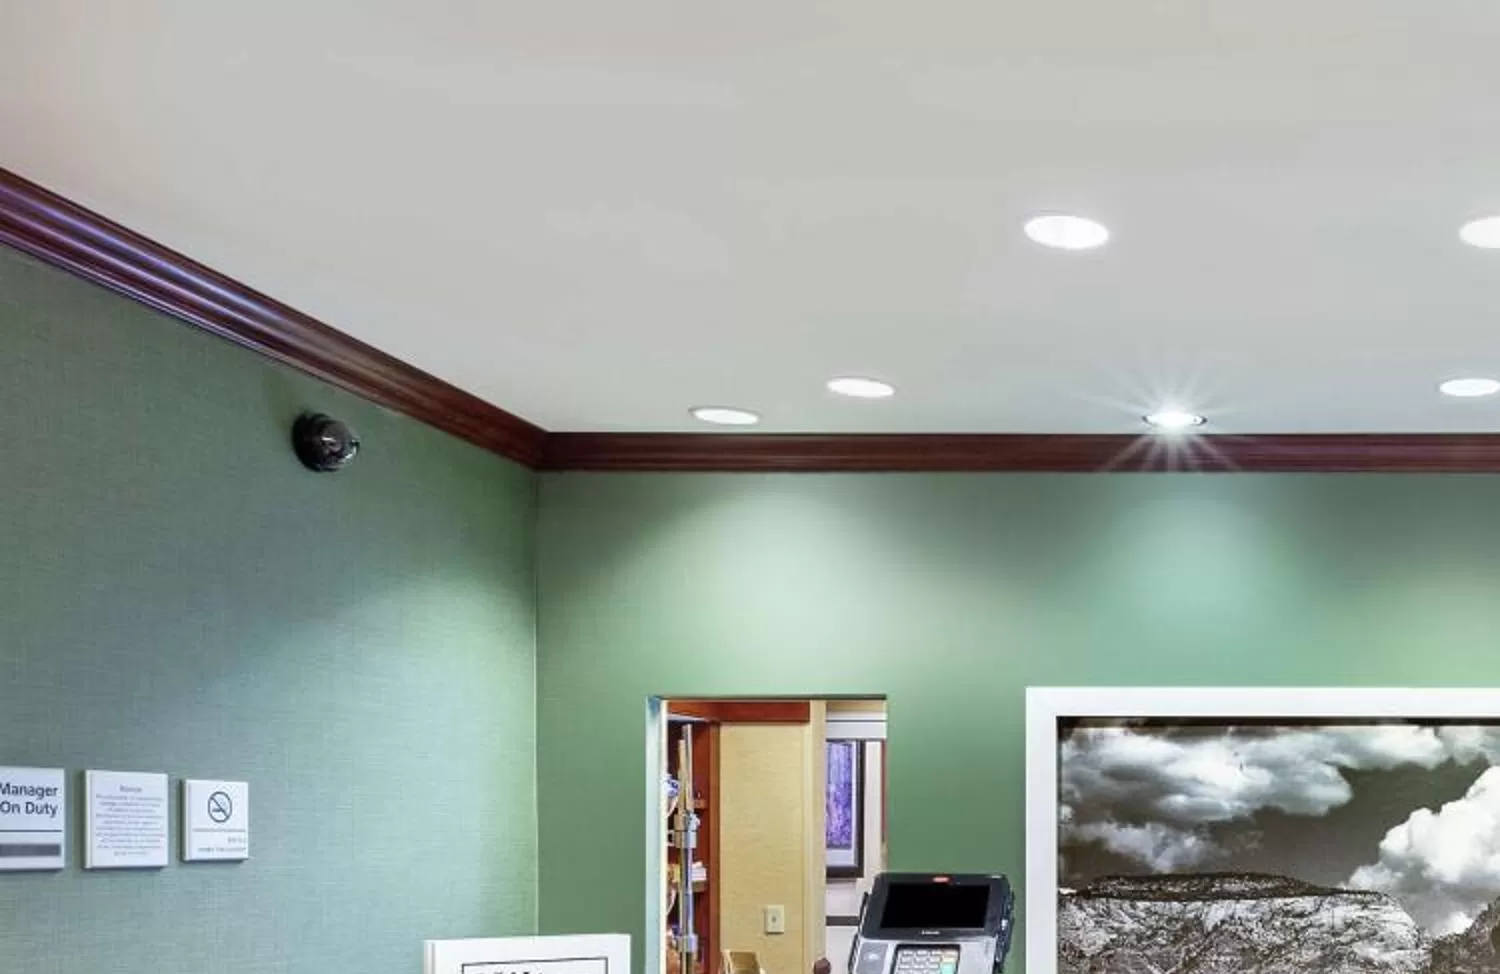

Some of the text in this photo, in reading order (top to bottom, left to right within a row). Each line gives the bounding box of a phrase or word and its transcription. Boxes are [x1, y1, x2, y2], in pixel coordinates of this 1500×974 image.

[0, 782, 58, 801] Manager
[0, 801, 58, 818] On Duty
